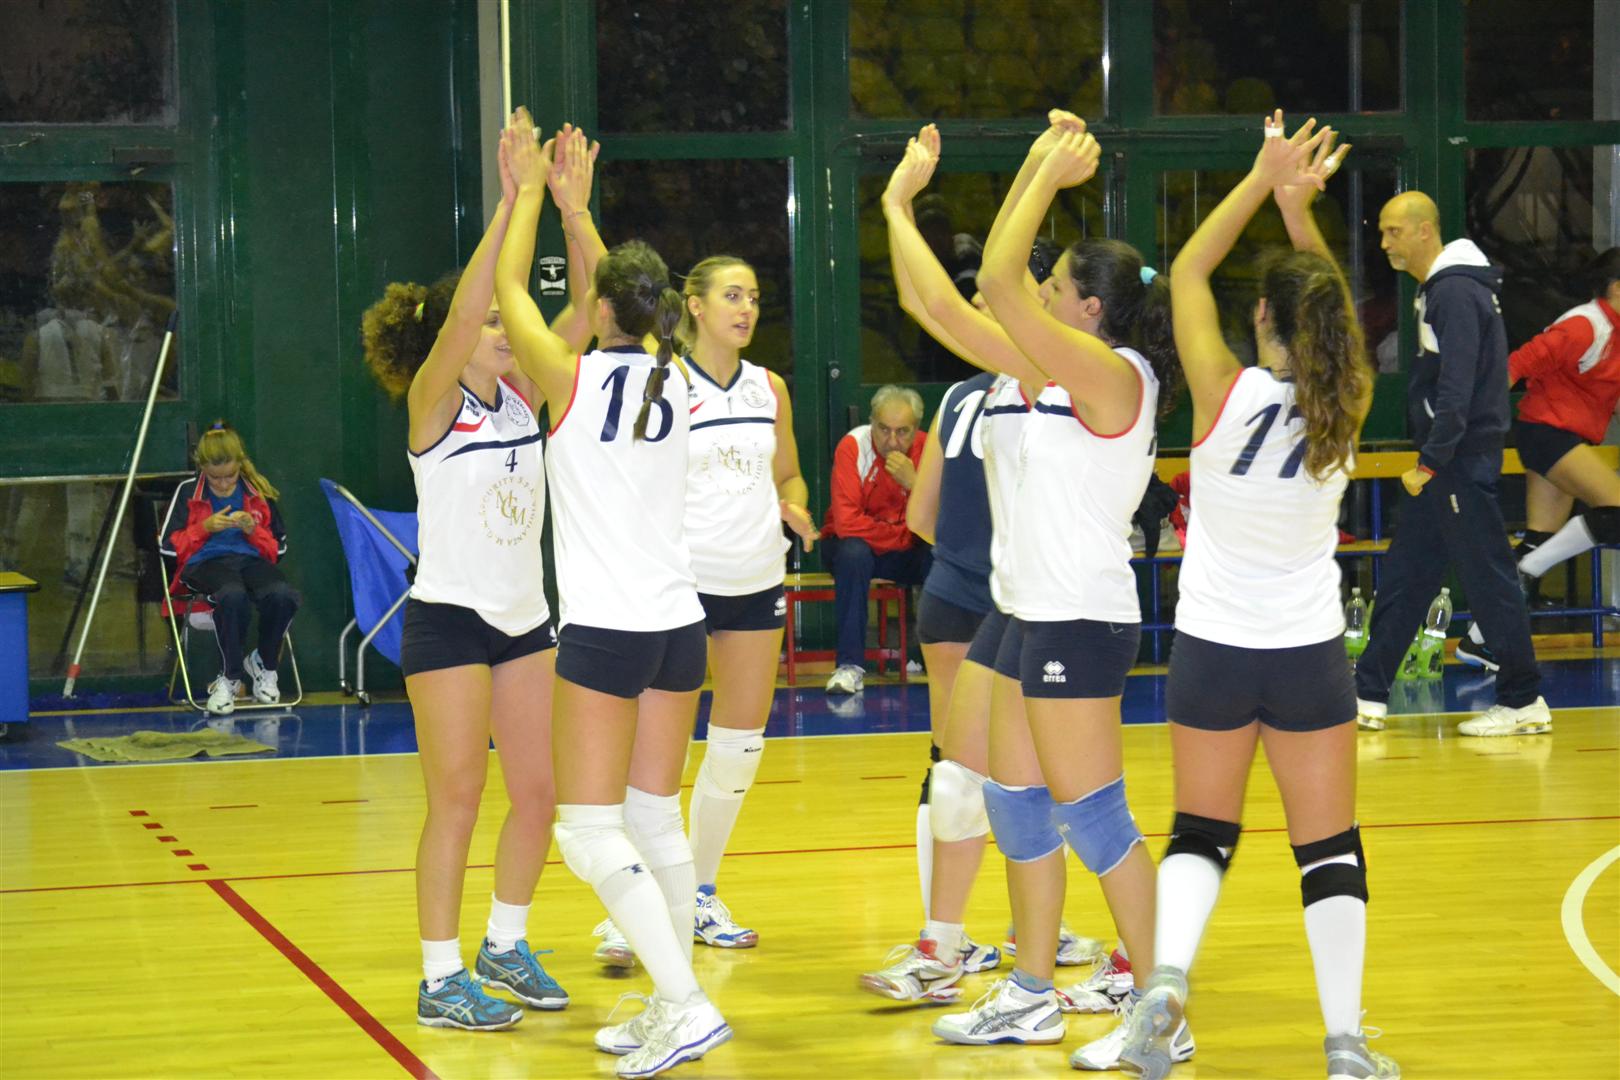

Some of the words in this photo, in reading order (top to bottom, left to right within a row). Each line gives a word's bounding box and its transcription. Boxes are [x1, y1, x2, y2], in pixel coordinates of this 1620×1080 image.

[1228, 403, 1306, 479] 17
[505, 448, 518, 473] 4
[1042, 674, 1067, 683] errea
